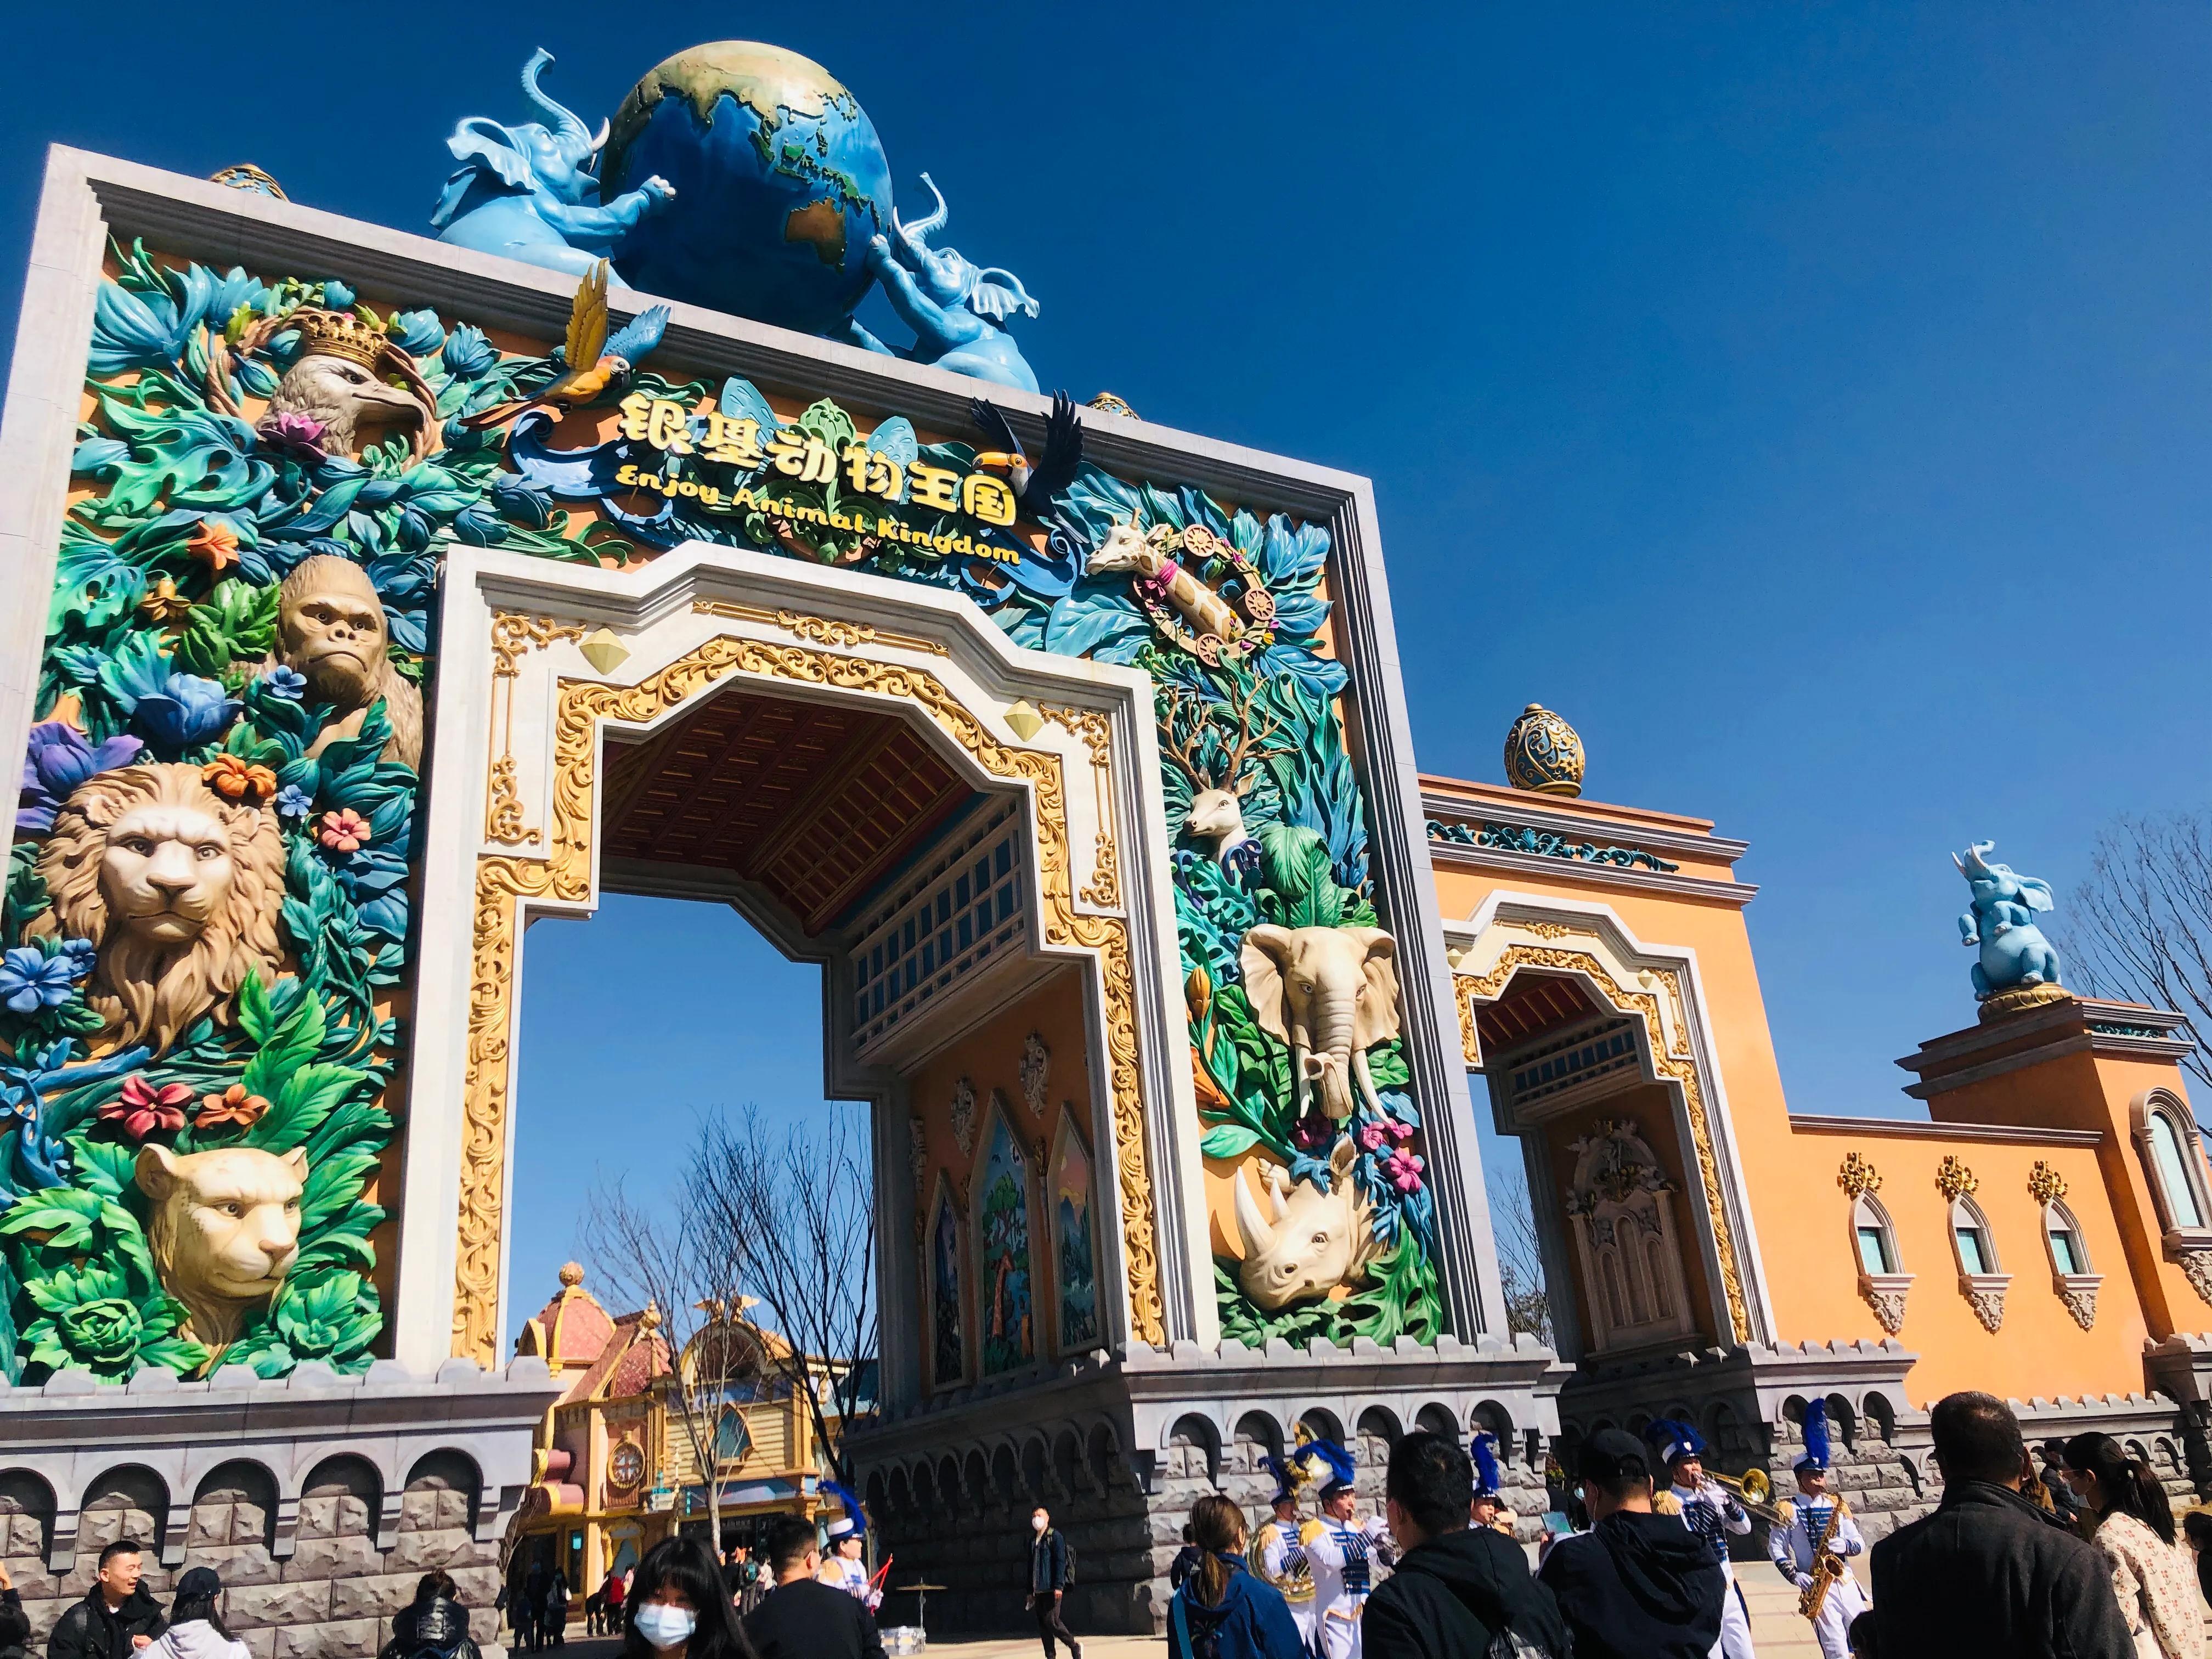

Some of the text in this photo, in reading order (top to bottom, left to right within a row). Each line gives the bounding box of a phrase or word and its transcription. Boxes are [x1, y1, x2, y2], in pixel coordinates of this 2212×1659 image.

[615, 465, 1021, 565] Enjoy Animal Kingdom
[619, 393, 1017, 526] 银基动物王国
